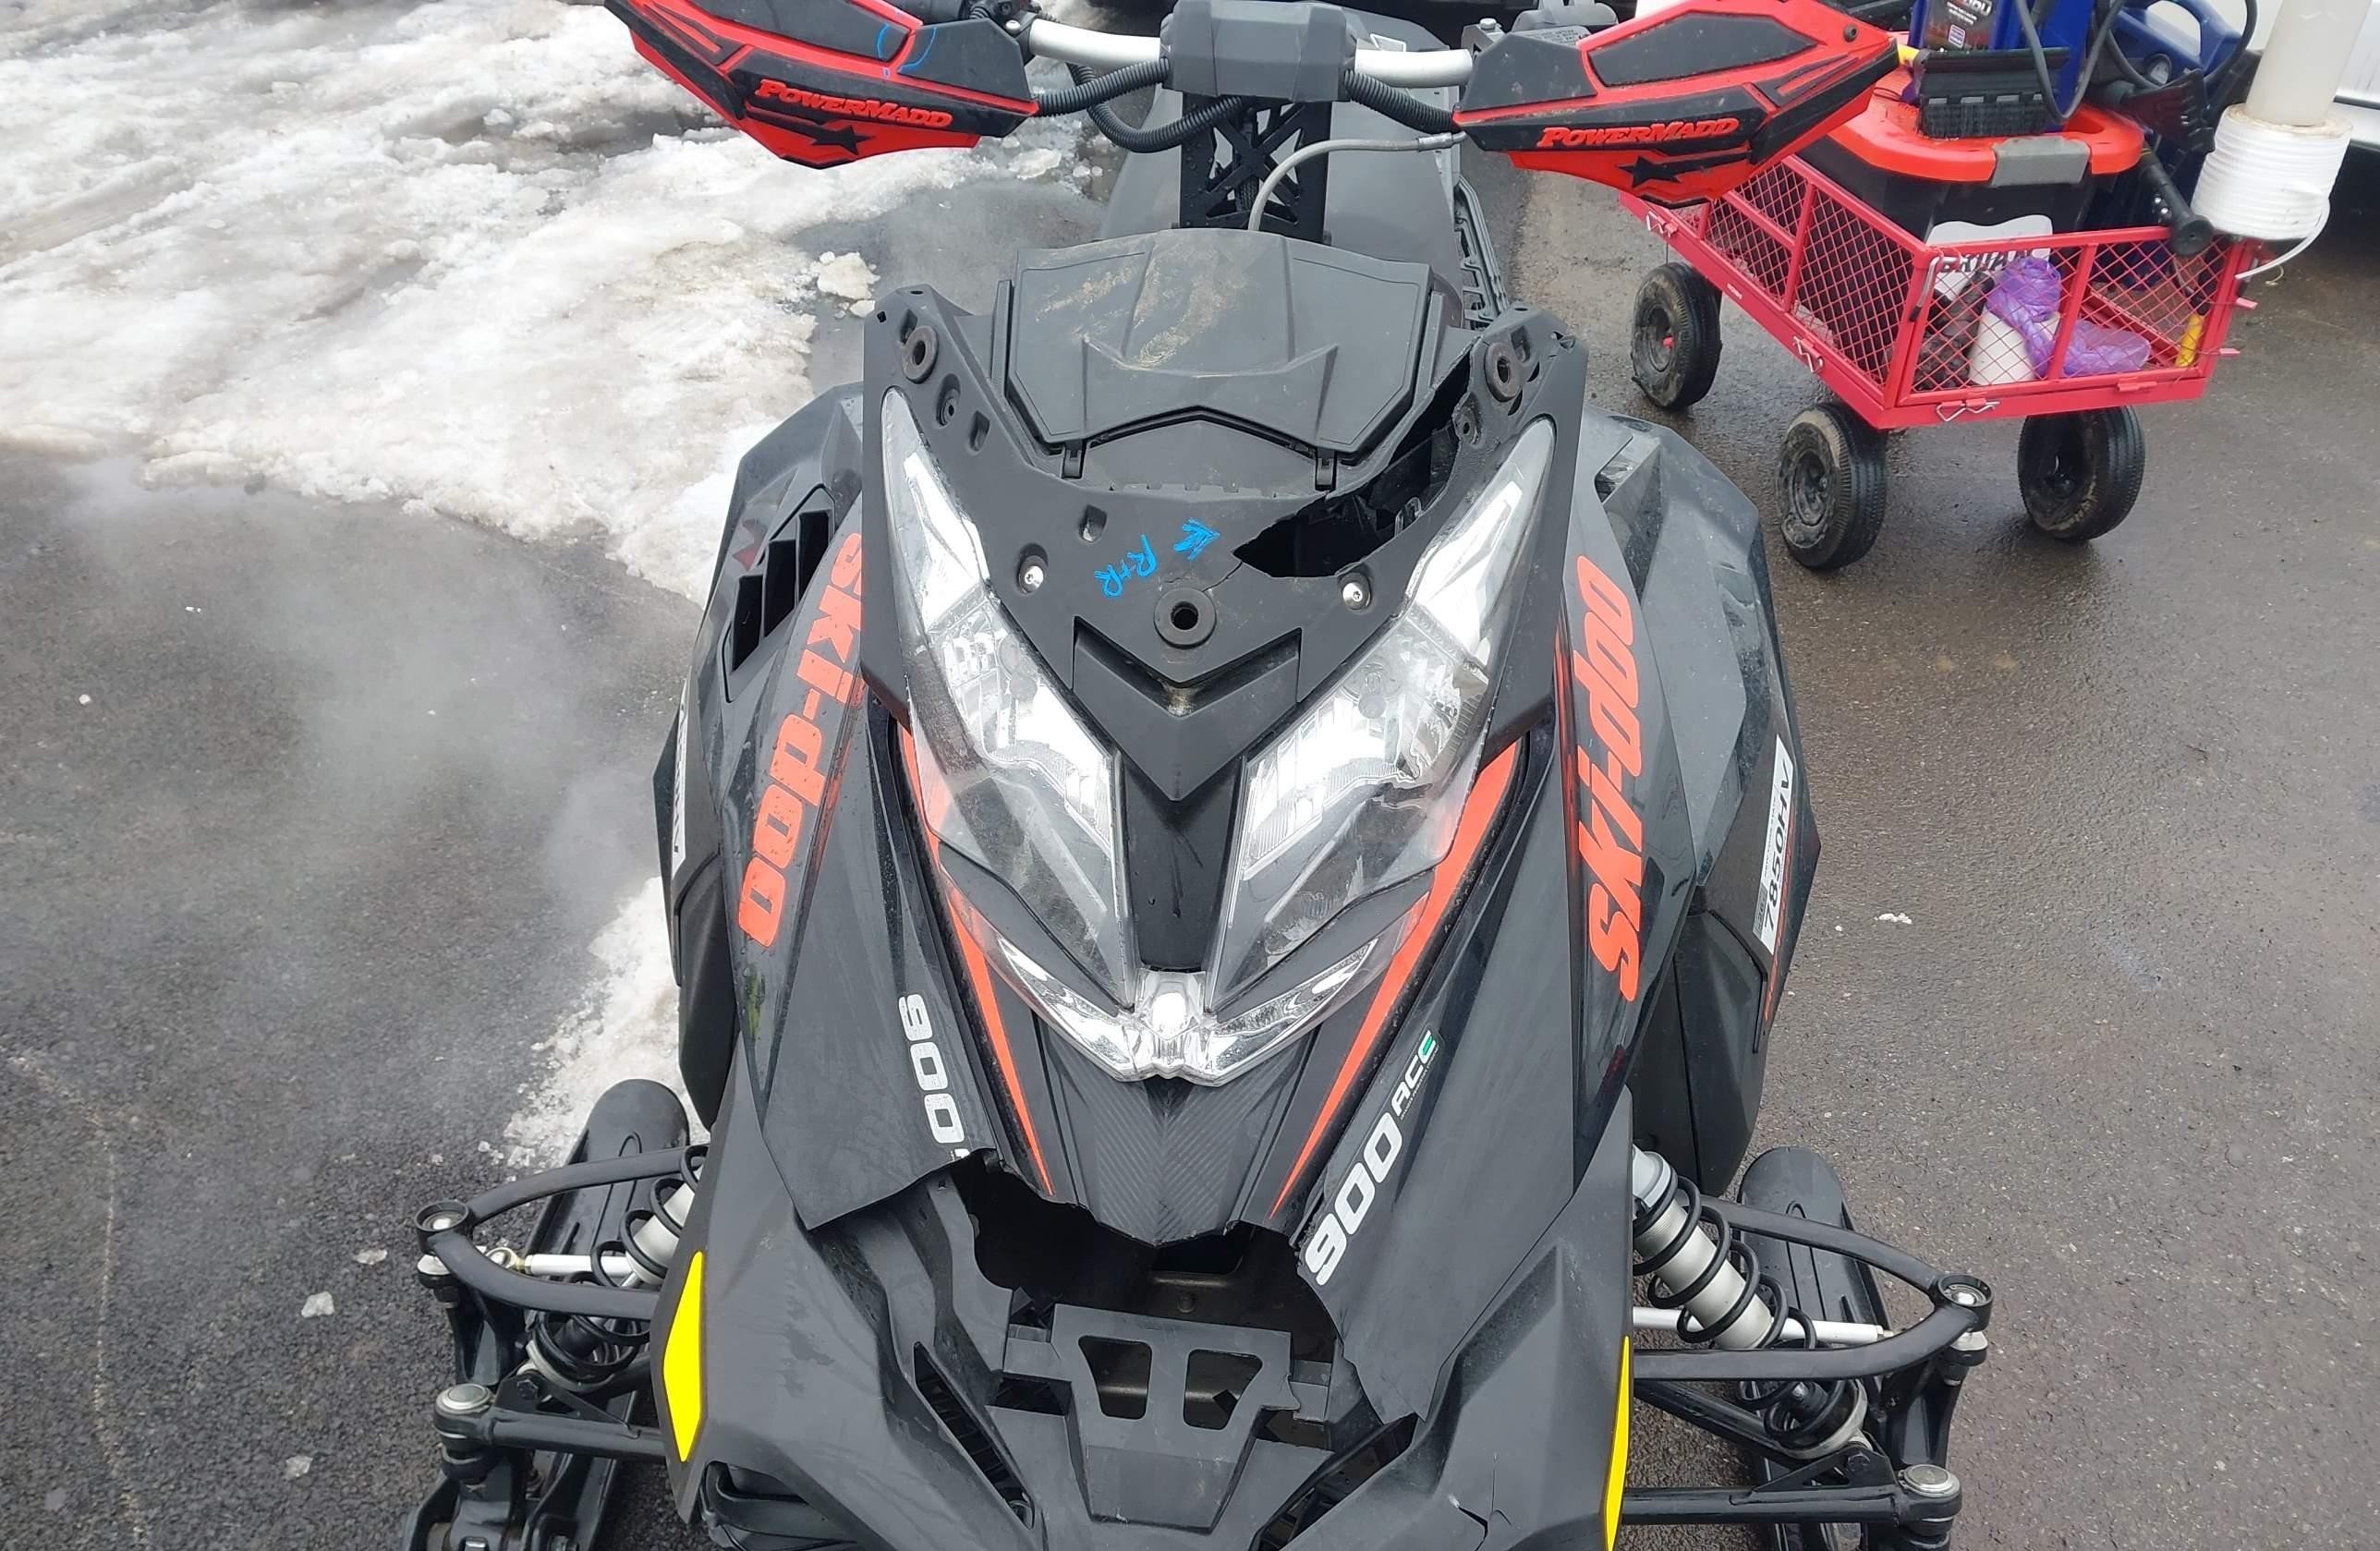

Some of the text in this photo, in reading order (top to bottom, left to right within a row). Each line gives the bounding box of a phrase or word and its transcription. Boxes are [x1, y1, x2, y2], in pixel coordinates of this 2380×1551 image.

[898, 994, 965, 1144] 900
[1305, 1029, 1437, 1286] 900 ACE
